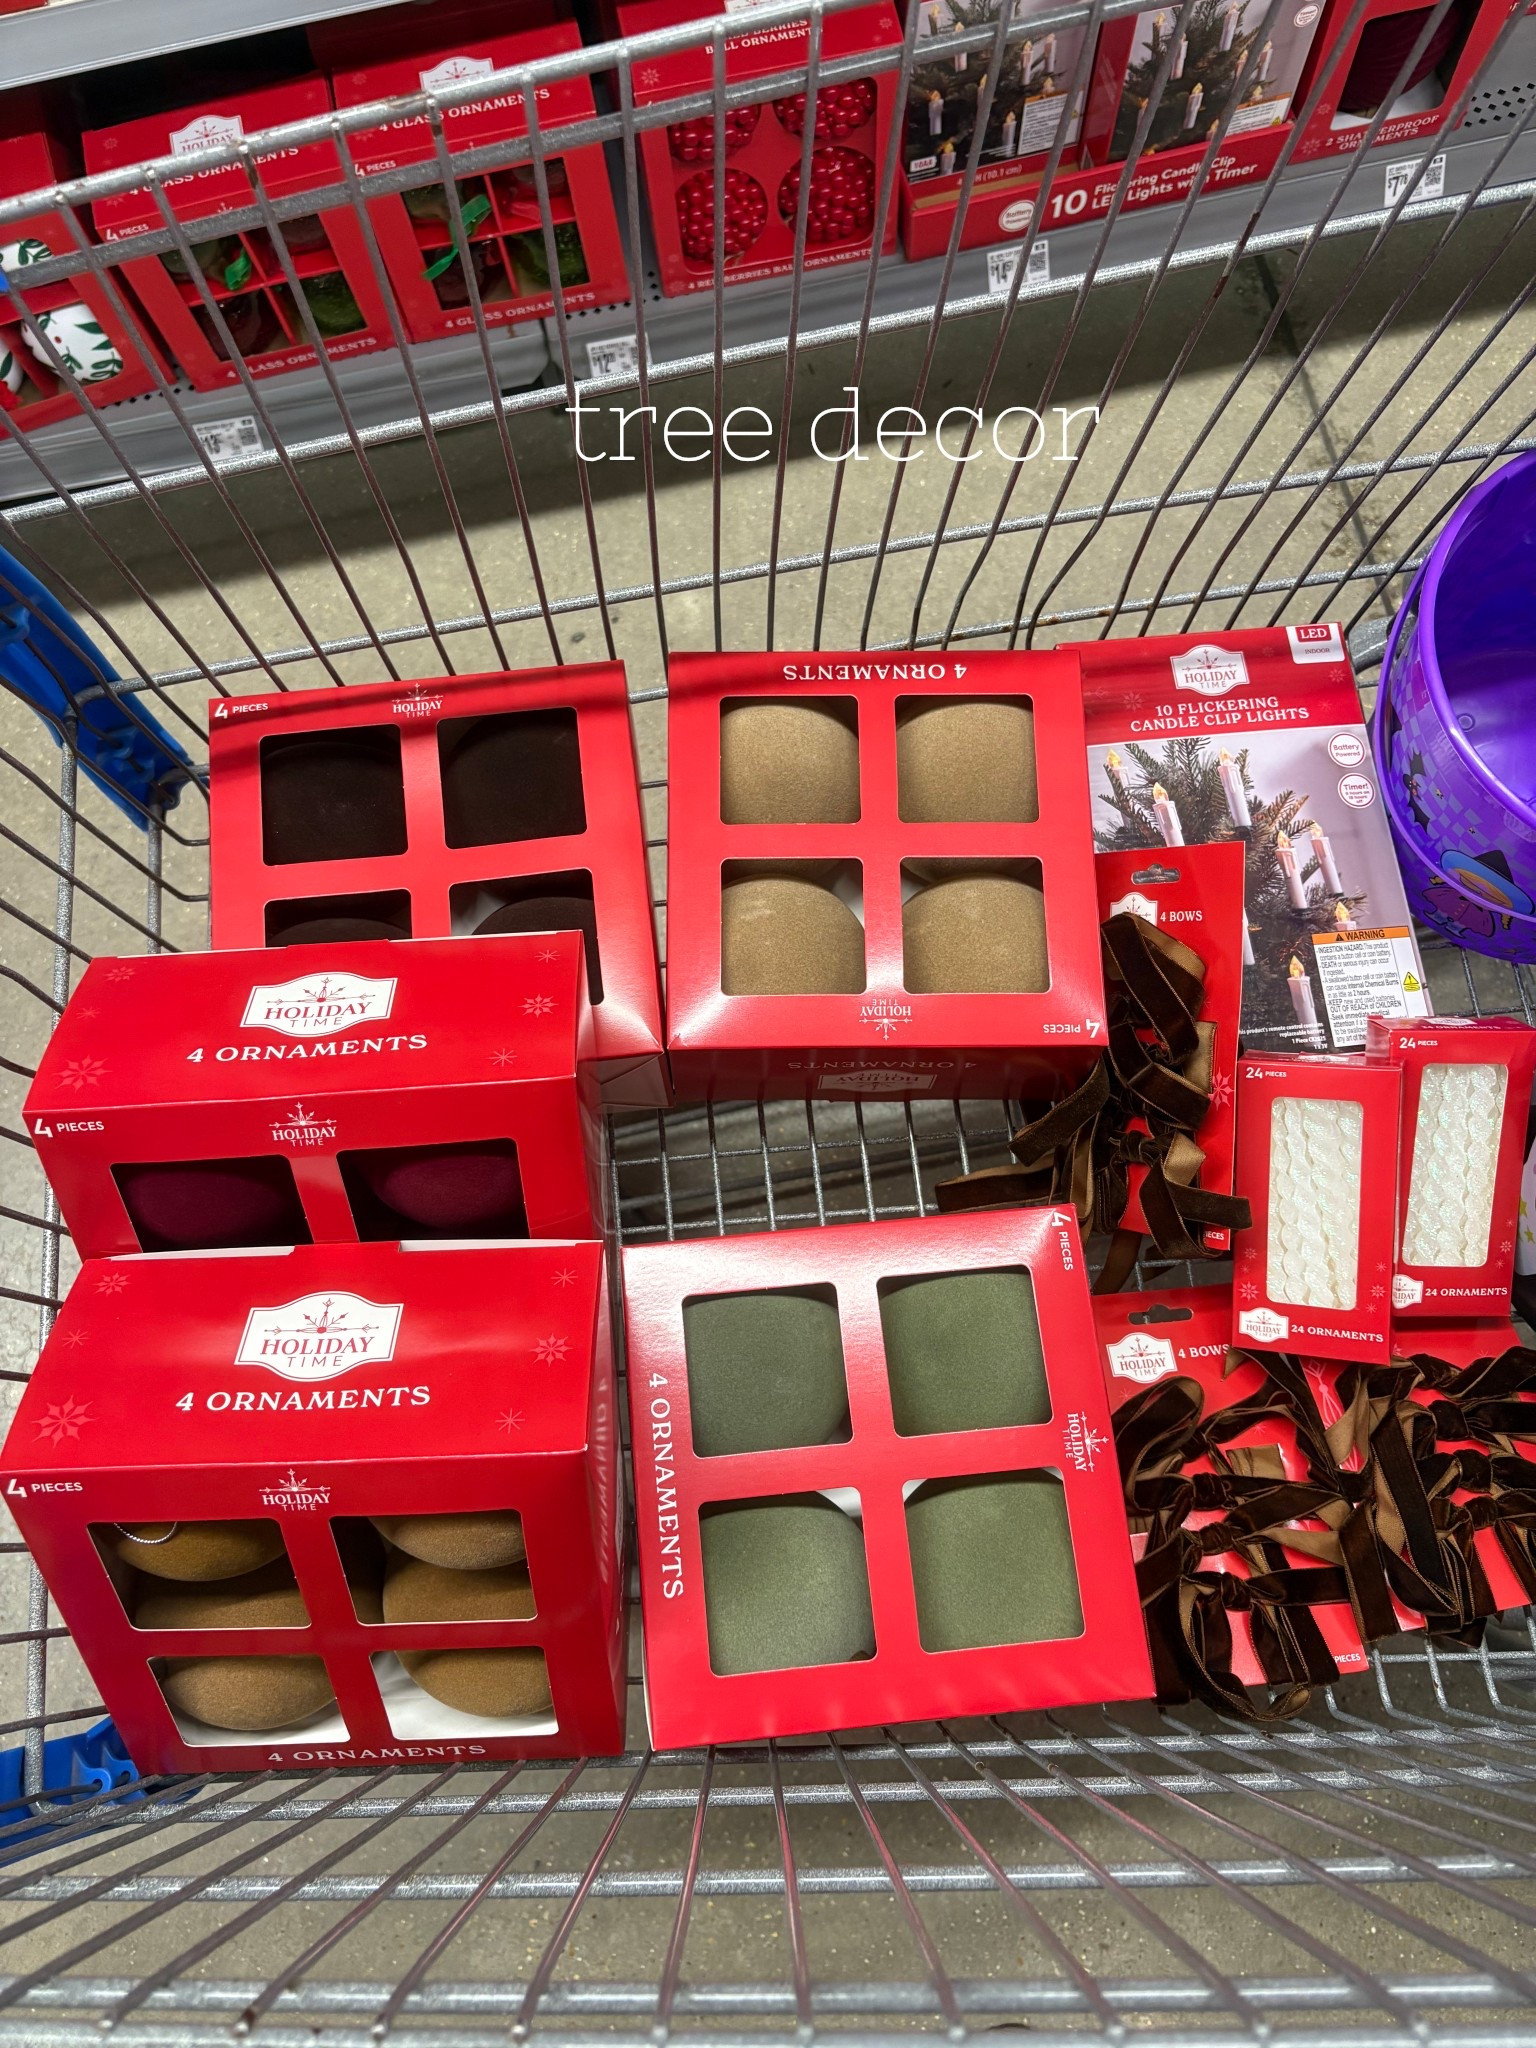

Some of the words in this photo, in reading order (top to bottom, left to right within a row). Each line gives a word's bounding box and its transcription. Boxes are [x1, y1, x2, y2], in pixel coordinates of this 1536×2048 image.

[706, 42, 738, 54] BLL
[1326, 138, 1333, 146] 2
[366, 160, 396, 173] PIECES
[1211, 156, 1236, 170] Clip
[1127, 182, 1173, 202] Lights
[1214, 163, 1258, 182] Timer
[1052, 189, 1088, 219] 10
[106, 229, 118, 241] 4
[119, 224, 149, 238] PIECES
[1300, 628, 1327, 639] LED
[783, 664, 946, 681] ORNAMENTS
[954, 664, 967, 679] 4
[1184, 669, 1237, 685] HOLIDAY
[1199, 679, 1227, 690] TIME
[214, 703, 228, 719] 4
[232, 702, 269, 714] PIECES
[393, 700, 443, 714] HOLIDAY
[1156, 704, 1173, 717] 10
[1178, 696, 1279, 715] FLICKERING
[406, 710, 432, 719] TIME
[1130, 714, 1200, 733] CANDLE
[1203, 711, 1243, 727] CLIP
[1246, 706, 1310, 724] LIGHTS
[1333, 744, 1359, 752] Battery
[1160, 912, 1167, 922] 4
[1169, 910, 1203, 922] BOWS
[1345, 930, 1385, 941] WARNING
[872, 998, 899, 1006] TIME
[263, 1000, 372, 1023] HOLIDAY
[860, 1006, 912, 1017] HOLIDAY
[289, 1016, 344, 1029] TIME
[1043, 1023, 1081, 1034] PIECES
[1085, 1018, 1100, 1039] 4
[186, 1047, 205, 1063] 4
[215, 1034, 429, 1063] ORNAMENTS
[1399, 1037, 1416, 1049] 24
[787, 1061, 954, 1069] ORNAMENTS
[1246, 1067, 1263, 1079] 24
[1265, 1070, 1287, 1078] PIECES
[34, 1118, 53, 1138] 4
[56, 1120, 105, 1134] PIECES
[272, 1126, 337, 1141] HOLIDAY
[290, 1137, 324, 1148] TIME
[1051, 1211, 1072, 1228] 4
[1058, 1231, 1074, 1271] PIECES
[1425, 1288, 1438, 1297] 24
[1440, 1287, 1508, 1297] ORNAMENTS
[1246, 1323, 1281, 1335] HOLIDAY
[1291, 1324, 1304, 1333] 24
[1307, 1326, 1384, 1343] ORNAMENTS
[259, 1336, 376, 1356] HOLIDAY
[1178, 1348, 1186, 1359] 4
[1190, 1343, 1231, 1358] BOWS
[287, 1355, 345, 1369] TIME
[1120, 1357, 1166, 1371] HOLIDAY
[1134, 1367, 1158, 1376] TIME
[649, 1372, 669, 1388] 4
[176, 1392, 195, 1412] 4
[206, 1385, 431, 1412] ORNAMENTS
[1061, 1429, 1074, 1459] TIME
[1067, 1413, 1087, 1472] HOLIDAY
[6, 1478, 28, 1499] 4
[31, 1481, 83, 1495] PIECES
[262, 1491, 331, 1507] HOLIDAY
[650, 1398, 684, 1599] ORNAMENTS
[281, 1502, 317, 1512] TIME
[1334, 1653, 1361, 1663] PIECES
[268, 1752, 283, 1762] 4
[293, 1745, 487, 1762] ORNAMENTS
